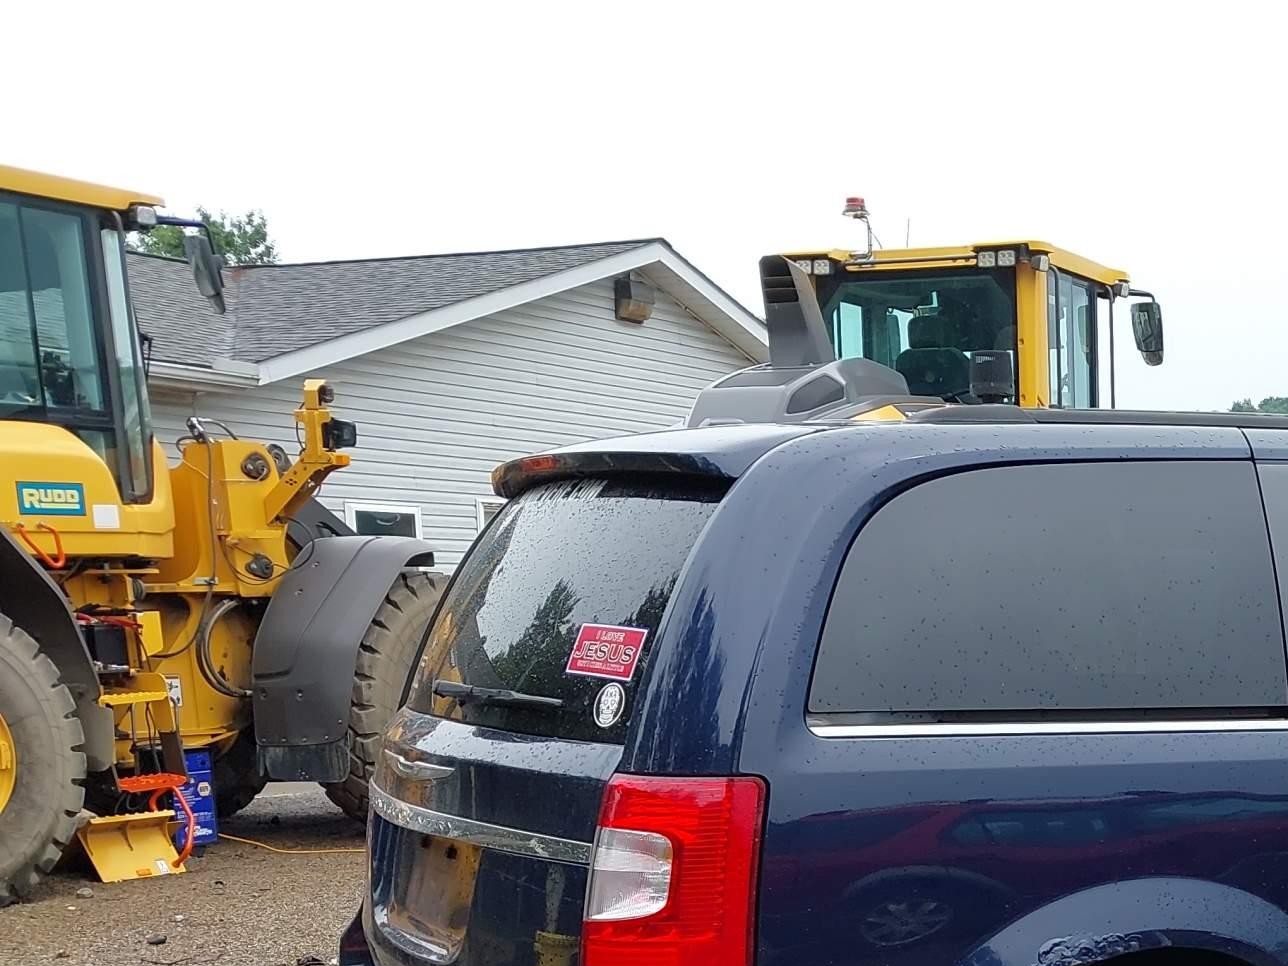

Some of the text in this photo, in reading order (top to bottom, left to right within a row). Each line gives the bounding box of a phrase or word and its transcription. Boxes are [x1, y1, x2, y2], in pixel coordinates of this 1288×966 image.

[22, 488, 80, 508] RUDD
[596, 630, 625, 642] I LOVE
[574, 641, 636, 664] JESUS
